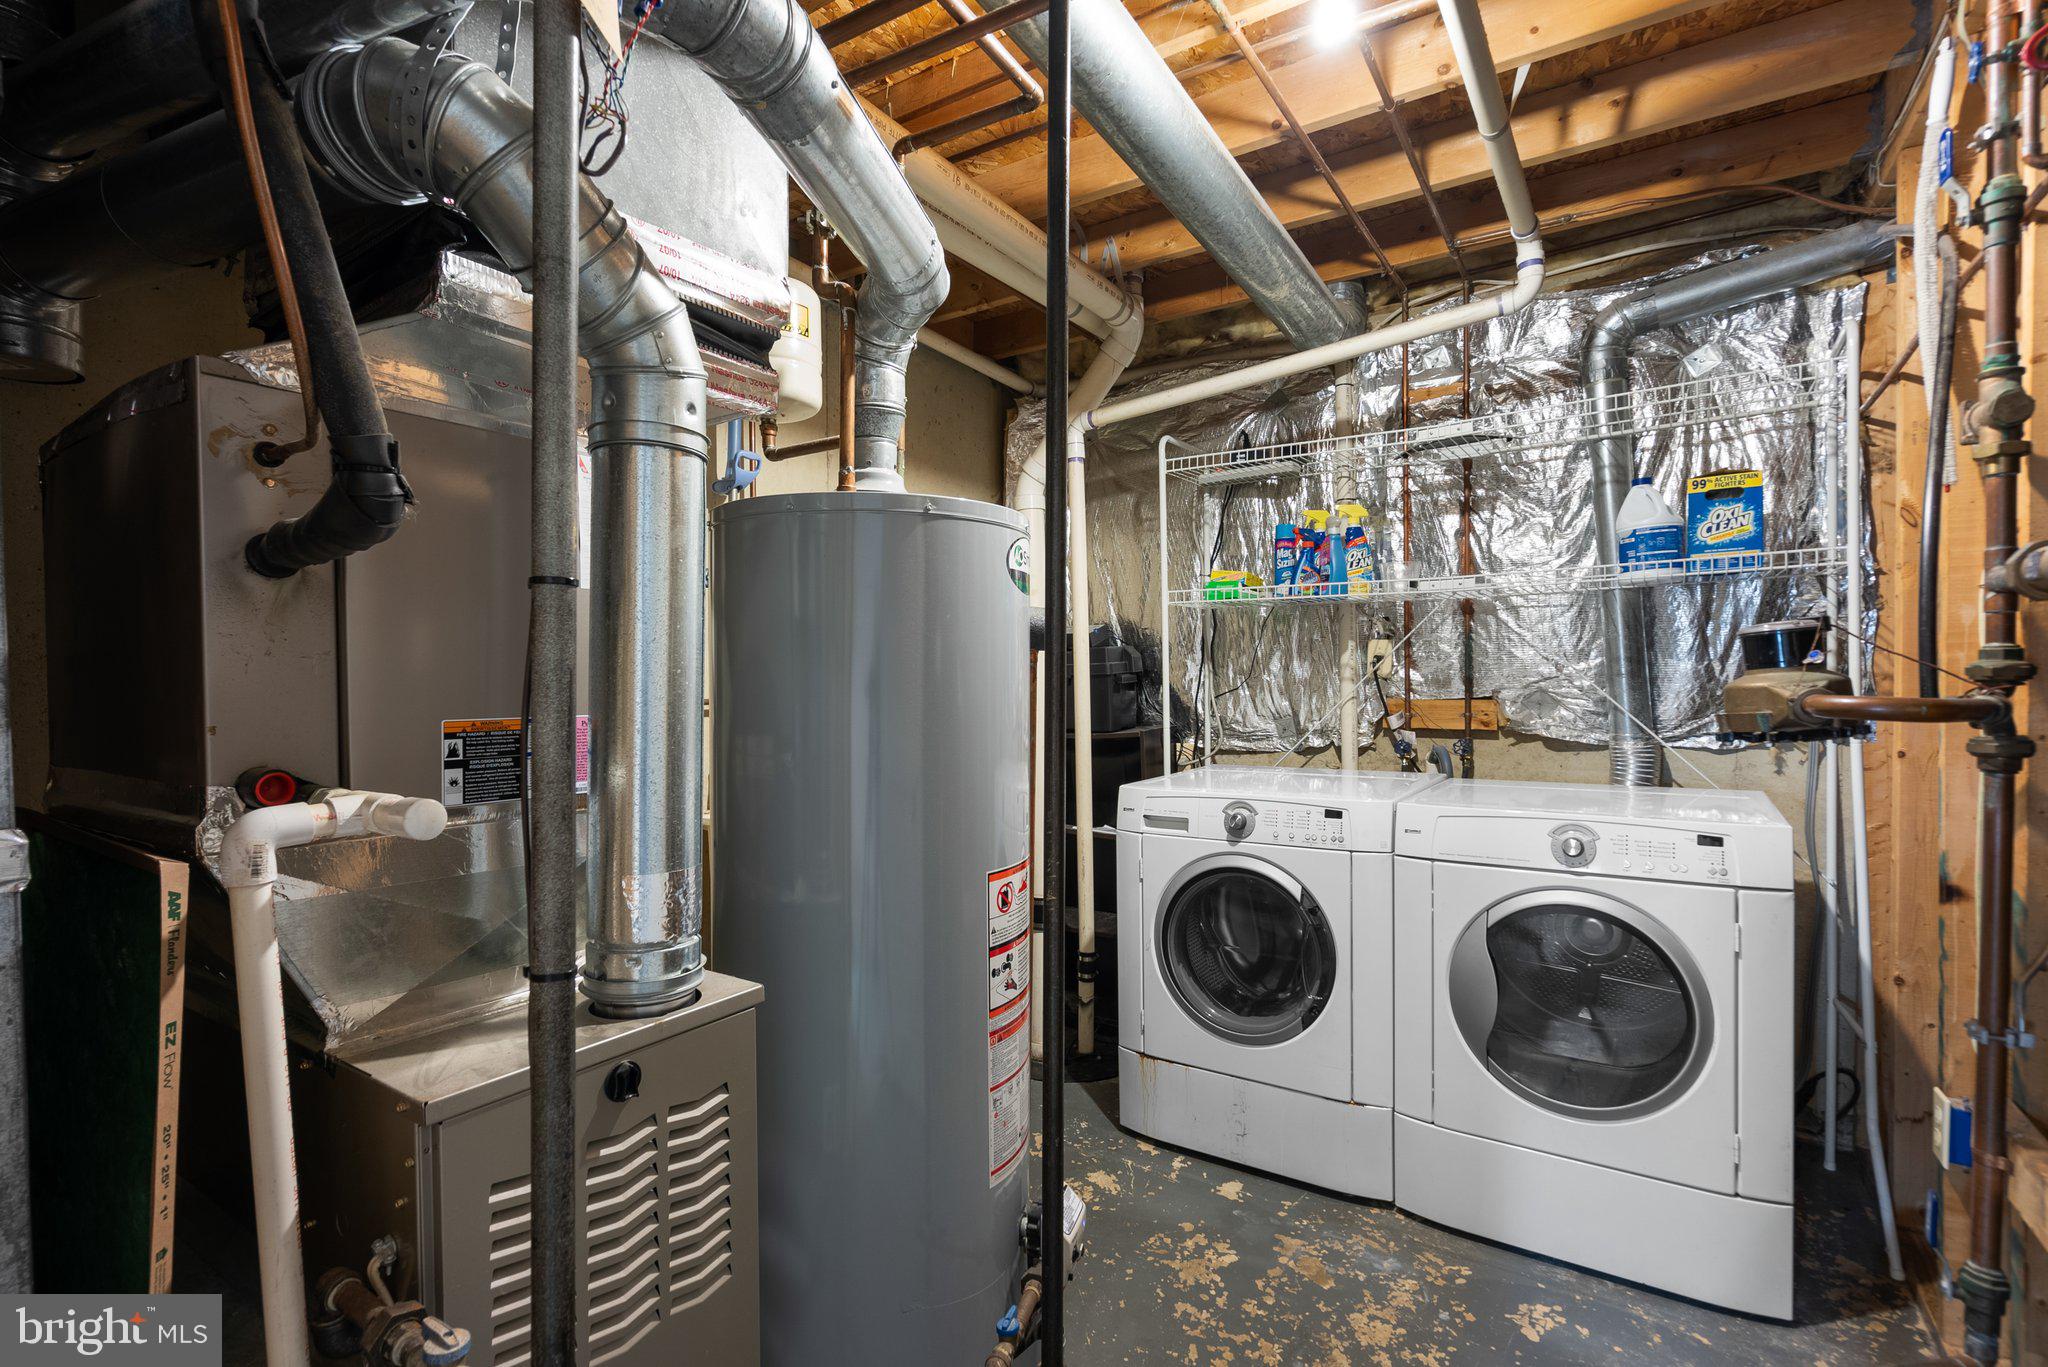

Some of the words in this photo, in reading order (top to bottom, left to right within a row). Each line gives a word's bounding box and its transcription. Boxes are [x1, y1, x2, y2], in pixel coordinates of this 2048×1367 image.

[1714, 480, 1747, 488] FIGHTERS
[1739, 472, 1760, 480] STAIN
[1701, 513, 1752, 539] CLEAN
[1711, 506, 1741, 525] OXI
[1348, 557, 1373, 571] LEAN
[168, 890, 181, 921] AAF
[167, 929, 180, 976] Flanders
[165, 1021, 177, 1050] EZ
[163, 1052, 176, 1089] Flow
